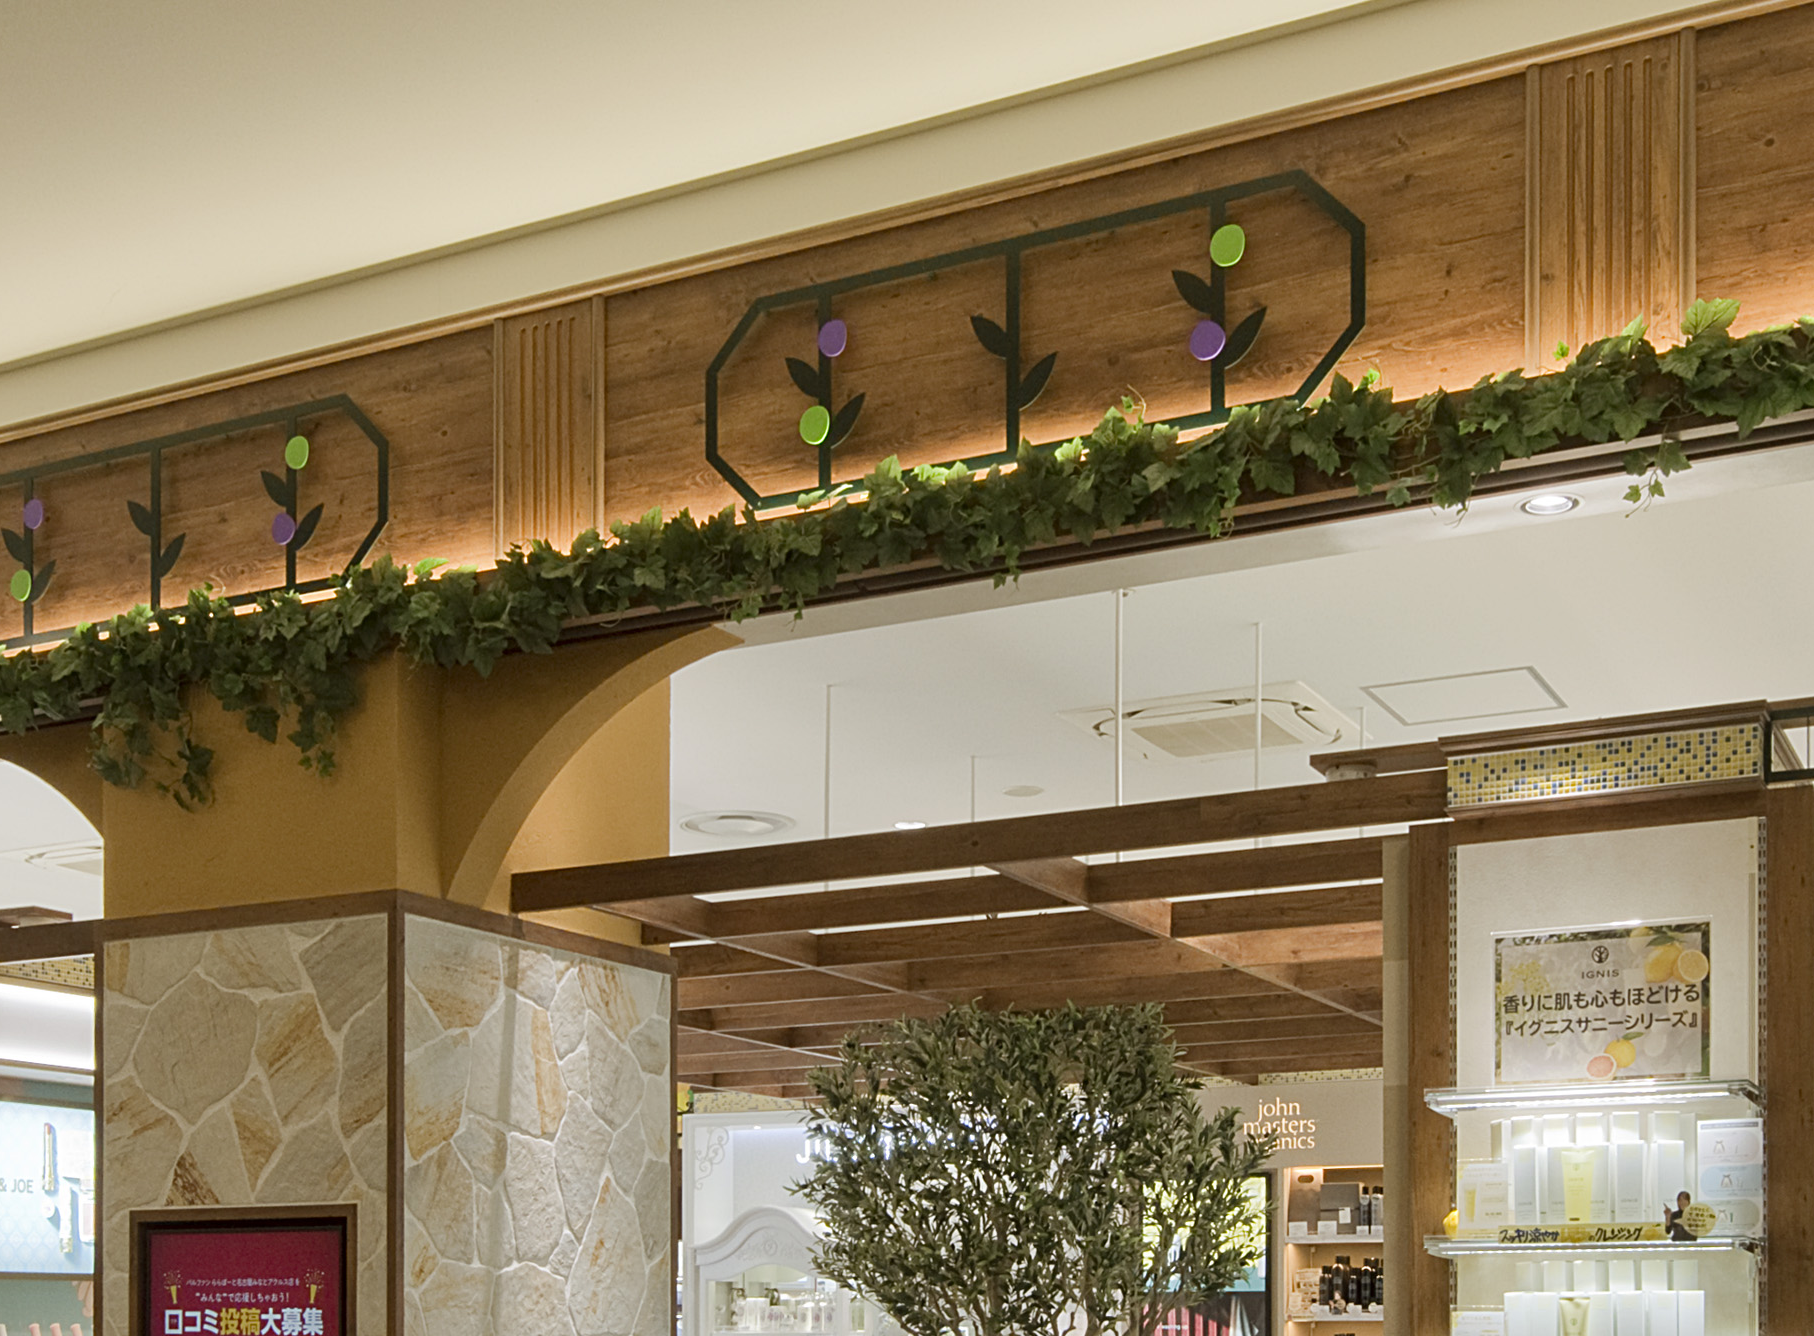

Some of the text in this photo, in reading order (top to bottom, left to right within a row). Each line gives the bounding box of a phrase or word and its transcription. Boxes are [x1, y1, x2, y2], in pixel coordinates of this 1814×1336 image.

[1581, 969, 1620, 980] IGNIS
[1503, 983, 1700, 1015] 香りに肌も心もほどける
[1505, 1010, 1698, 1037] 『イグニスサニーシリーズ』
[1258, 1097, 1301, 1123] john
[1243, 1117, 1316, 1136] masters
[11, 1179, 34, 1194] JOE
[164, 1307, 324, 1336] 口コミ投稿大募集
